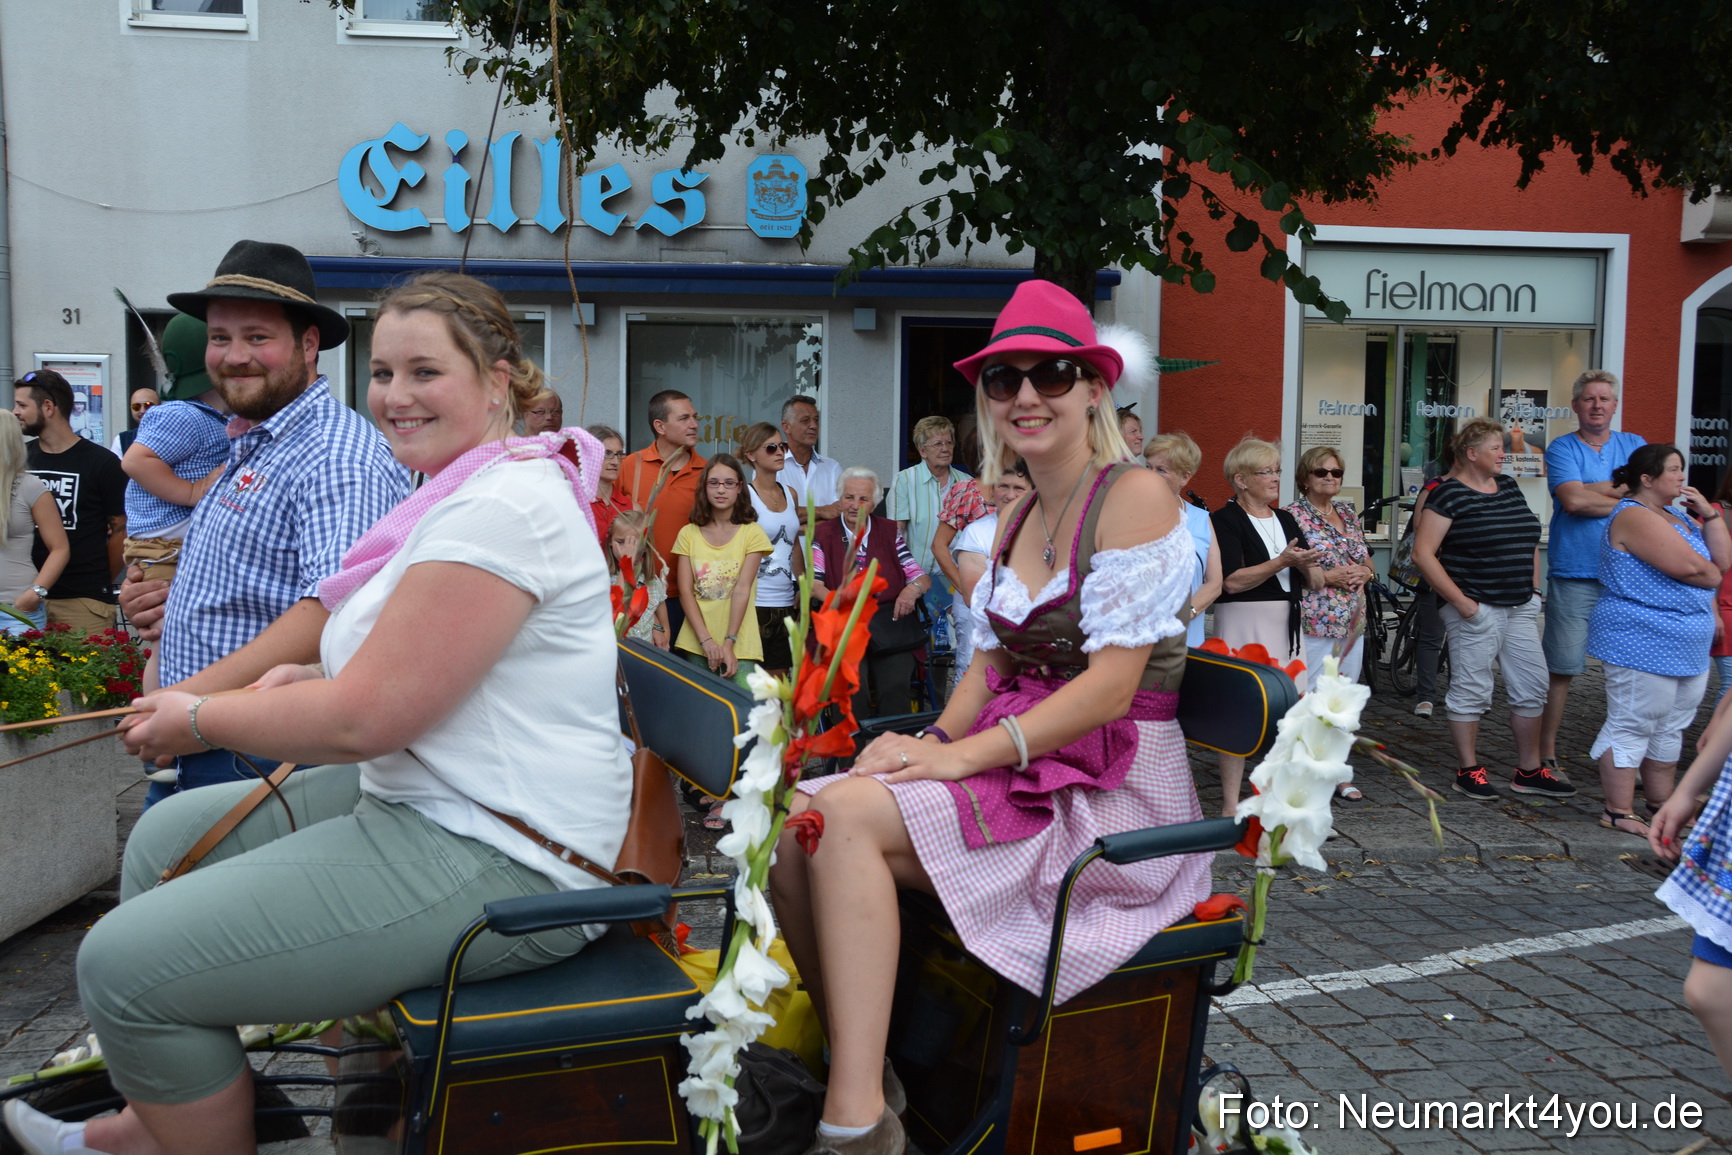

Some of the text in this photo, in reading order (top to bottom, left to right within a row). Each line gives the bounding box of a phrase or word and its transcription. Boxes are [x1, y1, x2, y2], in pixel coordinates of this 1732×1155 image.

[338, 121, 710, 236] Eilles
[1365, 268, 1537, 313] fielmann
[62, 307, 81, 325] 31
[1690, 416, 1729, 430] mann
[1690, 435, 1728, 448] mann
[1689, 453, 1727, 466] mann
